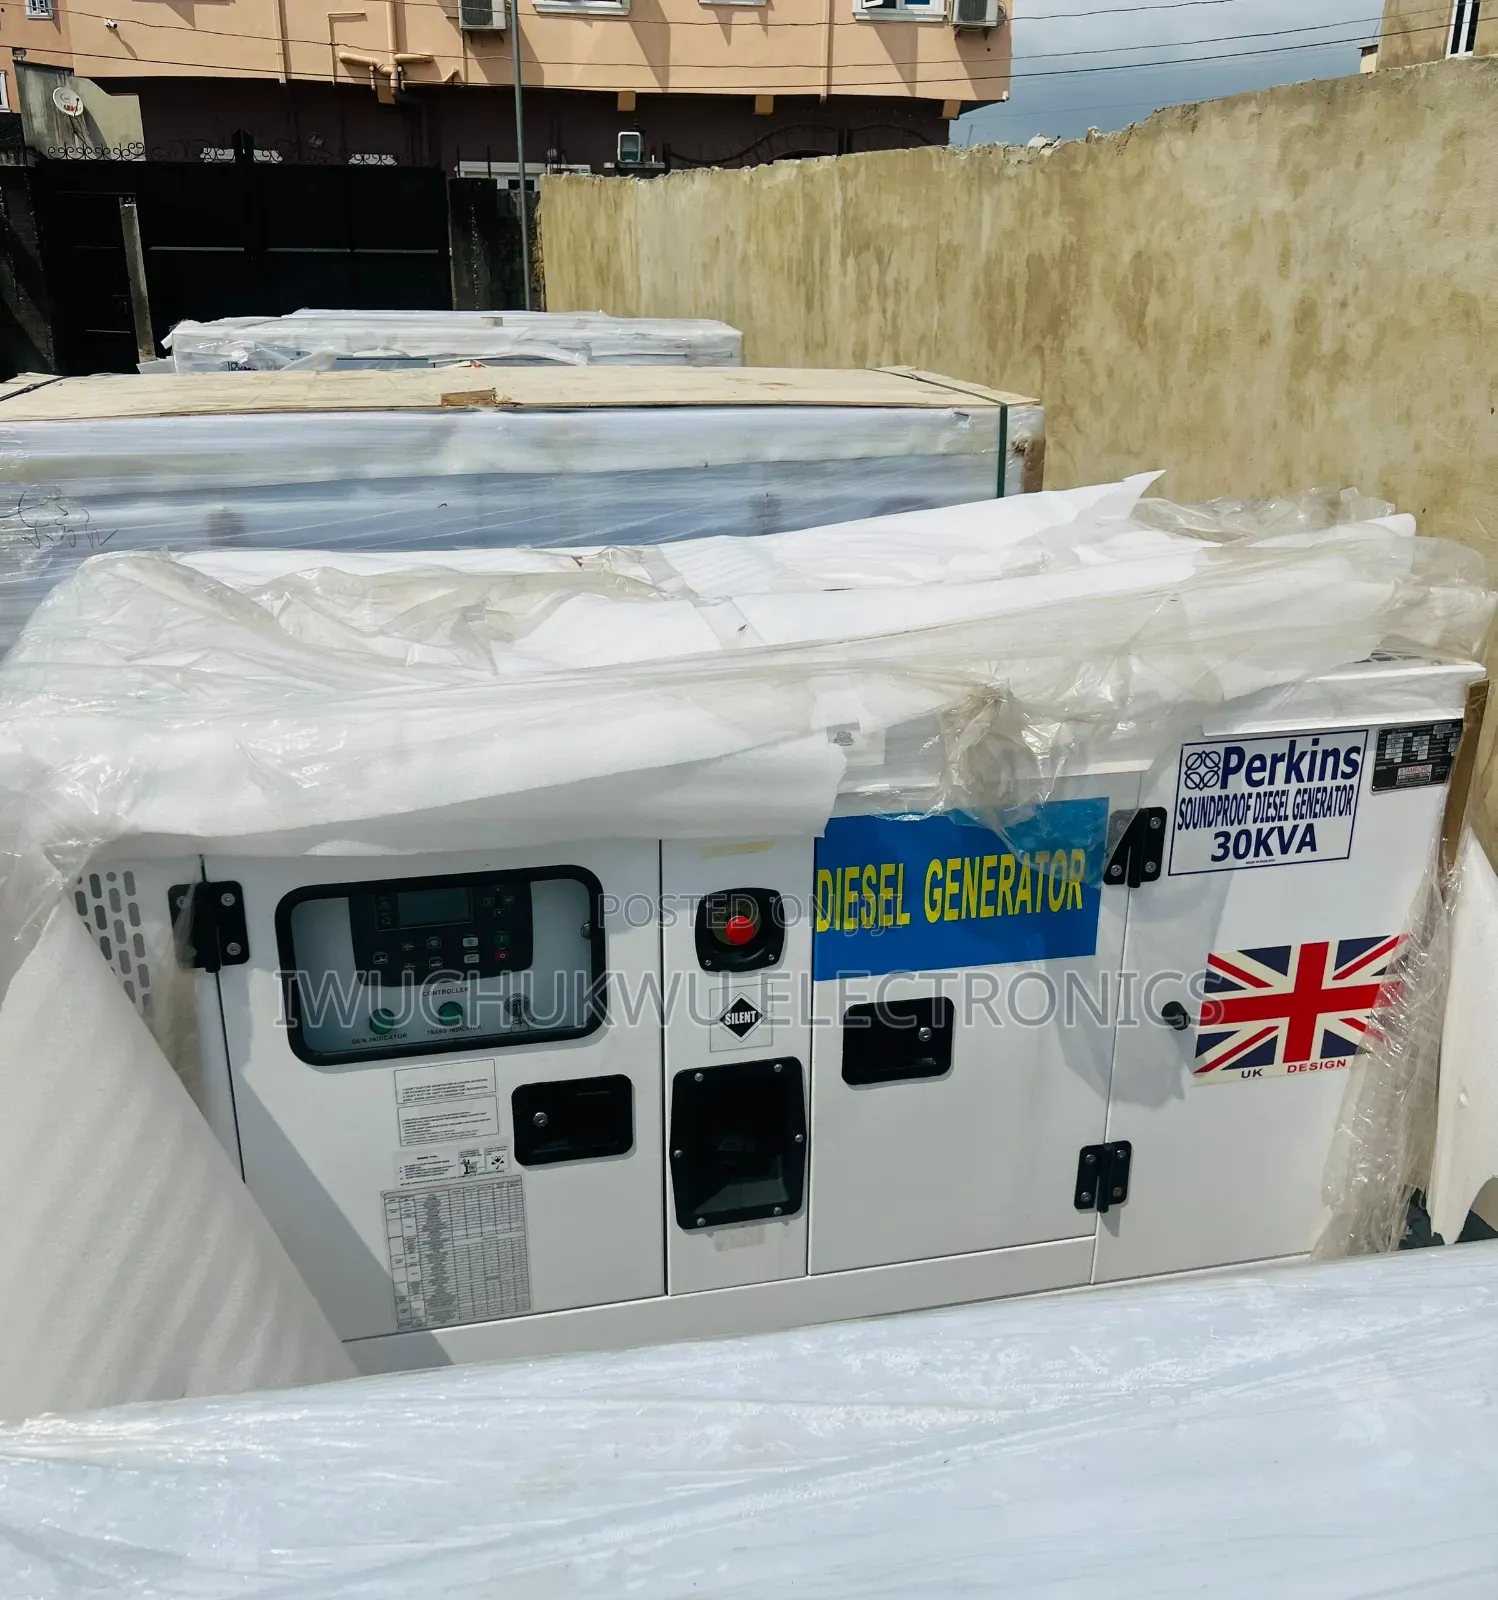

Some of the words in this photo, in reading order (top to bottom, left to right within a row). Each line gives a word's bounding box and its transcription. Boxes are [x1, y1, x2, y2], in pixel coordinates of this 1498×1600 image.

[1219, 737, 1362, 790] Perkins
[1177, 793, 1252, 831] SOUNDPROOF
[1252, 788, 1289, 824] DIESEL
[1292, 784, 1355, 820] GENERATOR
[1210, 823, 1318, 862] 30KVA
[816, 863, 911, 934] DIESEL
[924, 848, 1085, 924] GENERATOR
[422, 986, 469, 997] CONTROLLER
[724, 1010, 757, 1026] SILENT
[1240, 1067, 1263, 1080] UK
[1286, 1058, 1348, 1074] DESIGN
